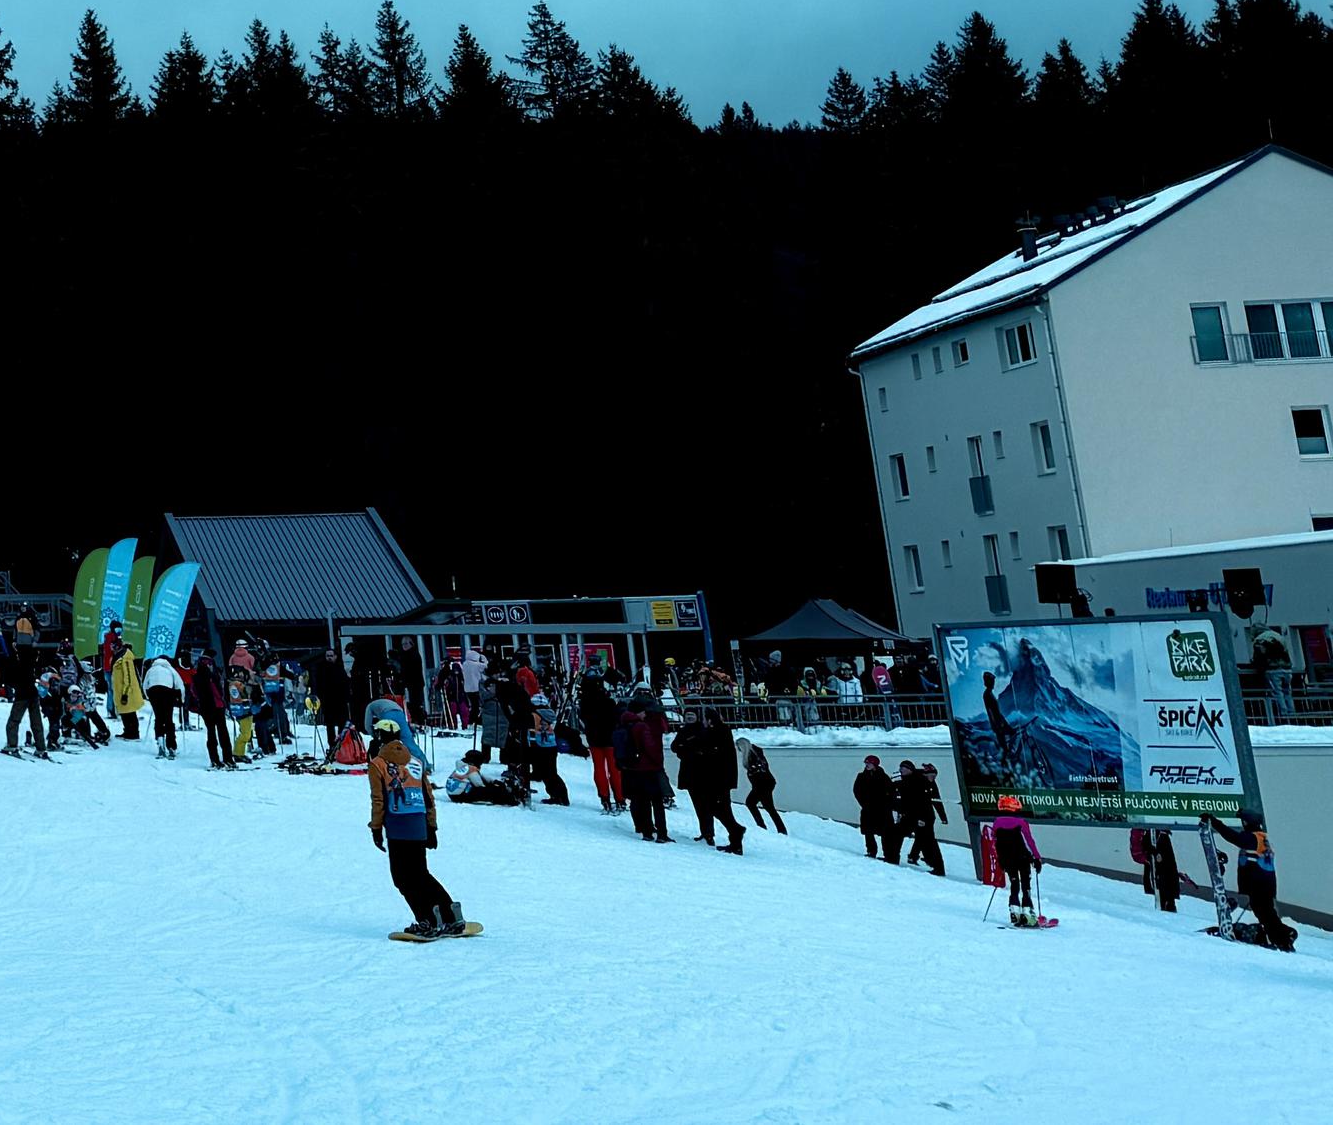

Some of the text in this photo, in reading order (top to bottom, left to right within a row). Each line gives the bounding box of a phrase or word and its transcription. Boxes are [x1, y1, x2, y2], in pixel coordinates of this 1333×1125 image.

[1169, 636, 1209, 655] BIKE
[1172, 655, 1213, 673] PARK
[1149, 766, 1217, 777] ROCK
[1160, 777, 1235, 786] MACHINE
[971, 790, 1240, 812] NOVÁ KTROKOLA V NEJVĚTŠÍ PŮJČOVNĚ V REGIONU
